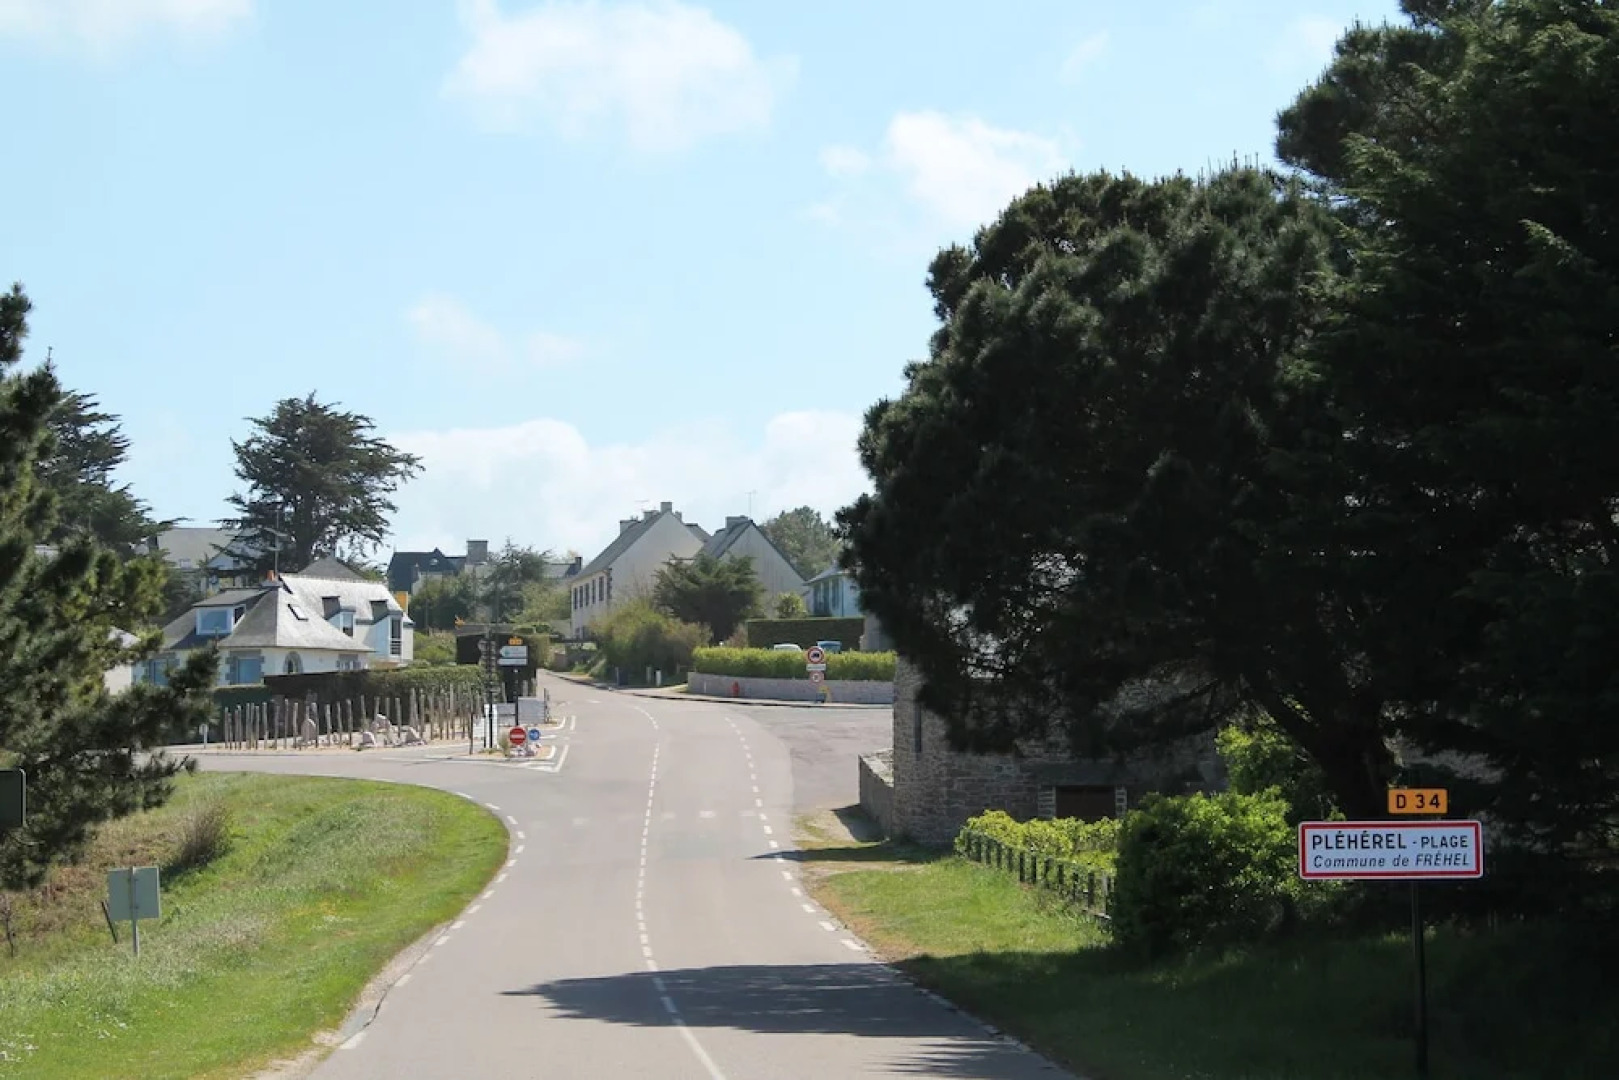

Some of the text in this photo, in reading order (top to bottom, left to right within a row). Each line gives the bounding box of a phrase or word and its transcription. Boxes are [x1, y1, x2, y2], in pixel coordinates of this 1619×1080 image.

[1396, 794, 1440, 809] D 34
[1312, 830, 1407, 850] PLÉHÉREL
[1313, 851, 1470, 869] Commune de FRÉHEL
